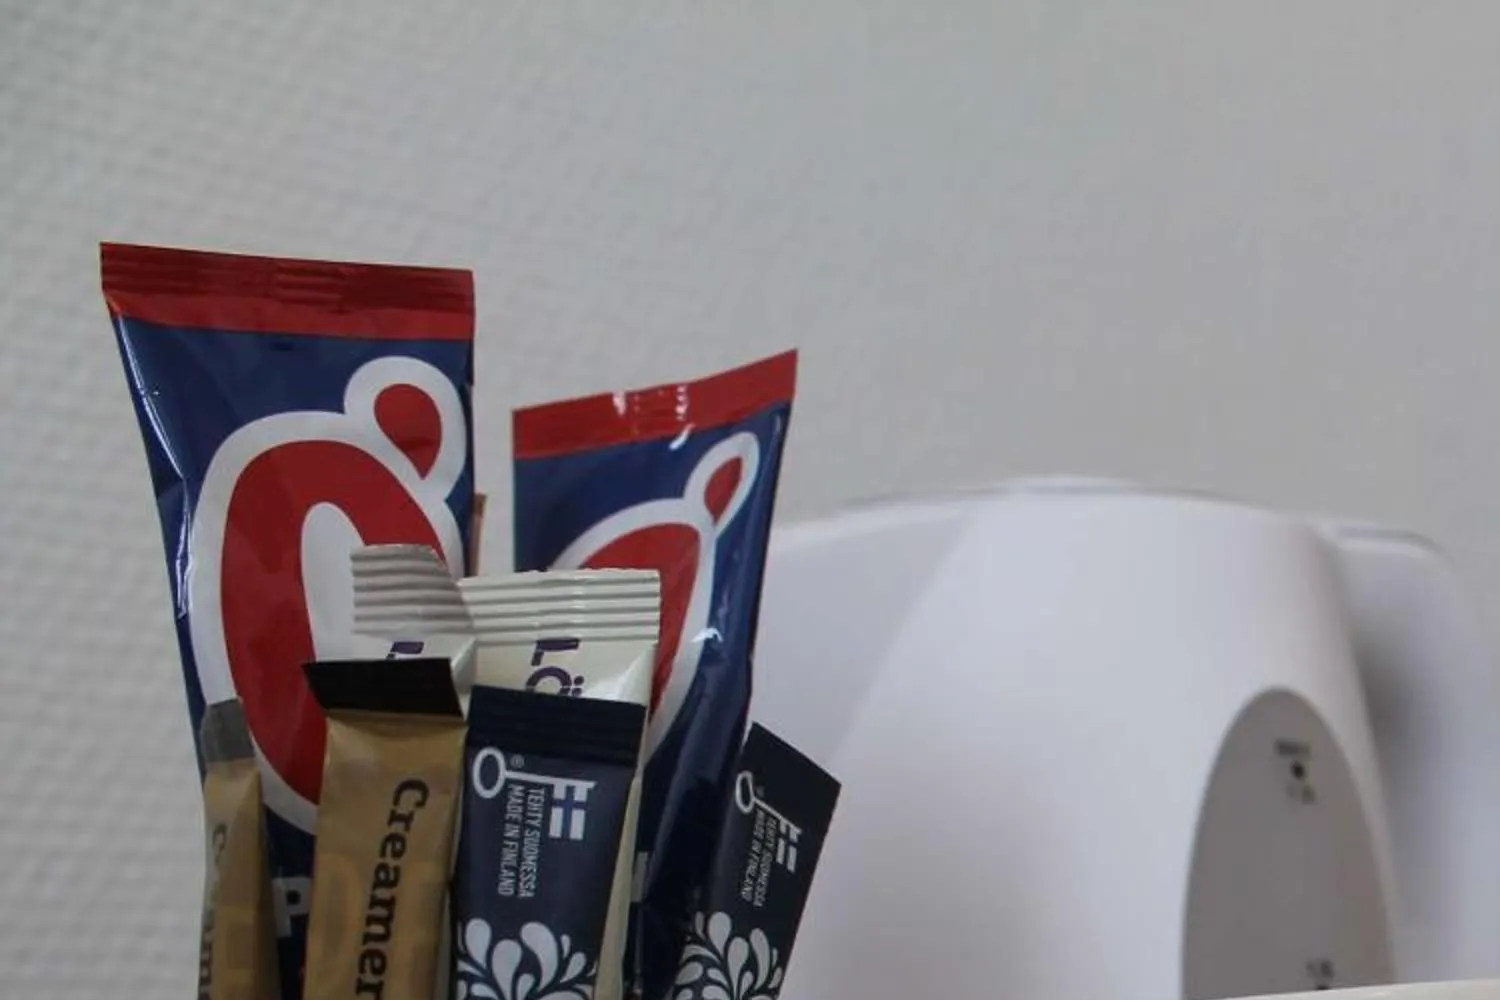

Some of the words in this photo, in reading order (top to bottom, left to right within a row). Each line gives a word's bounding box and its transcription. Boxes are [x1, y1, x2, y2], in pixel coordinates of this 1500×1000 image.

[505, 784, 524, 821] MADE
[527, 787, 545, 825] TEHTY
[504, 823, 521, 838] IN
[498, 840, 518, 896] FINLAND
[519, 828, 540, 897] SUOMESSA
